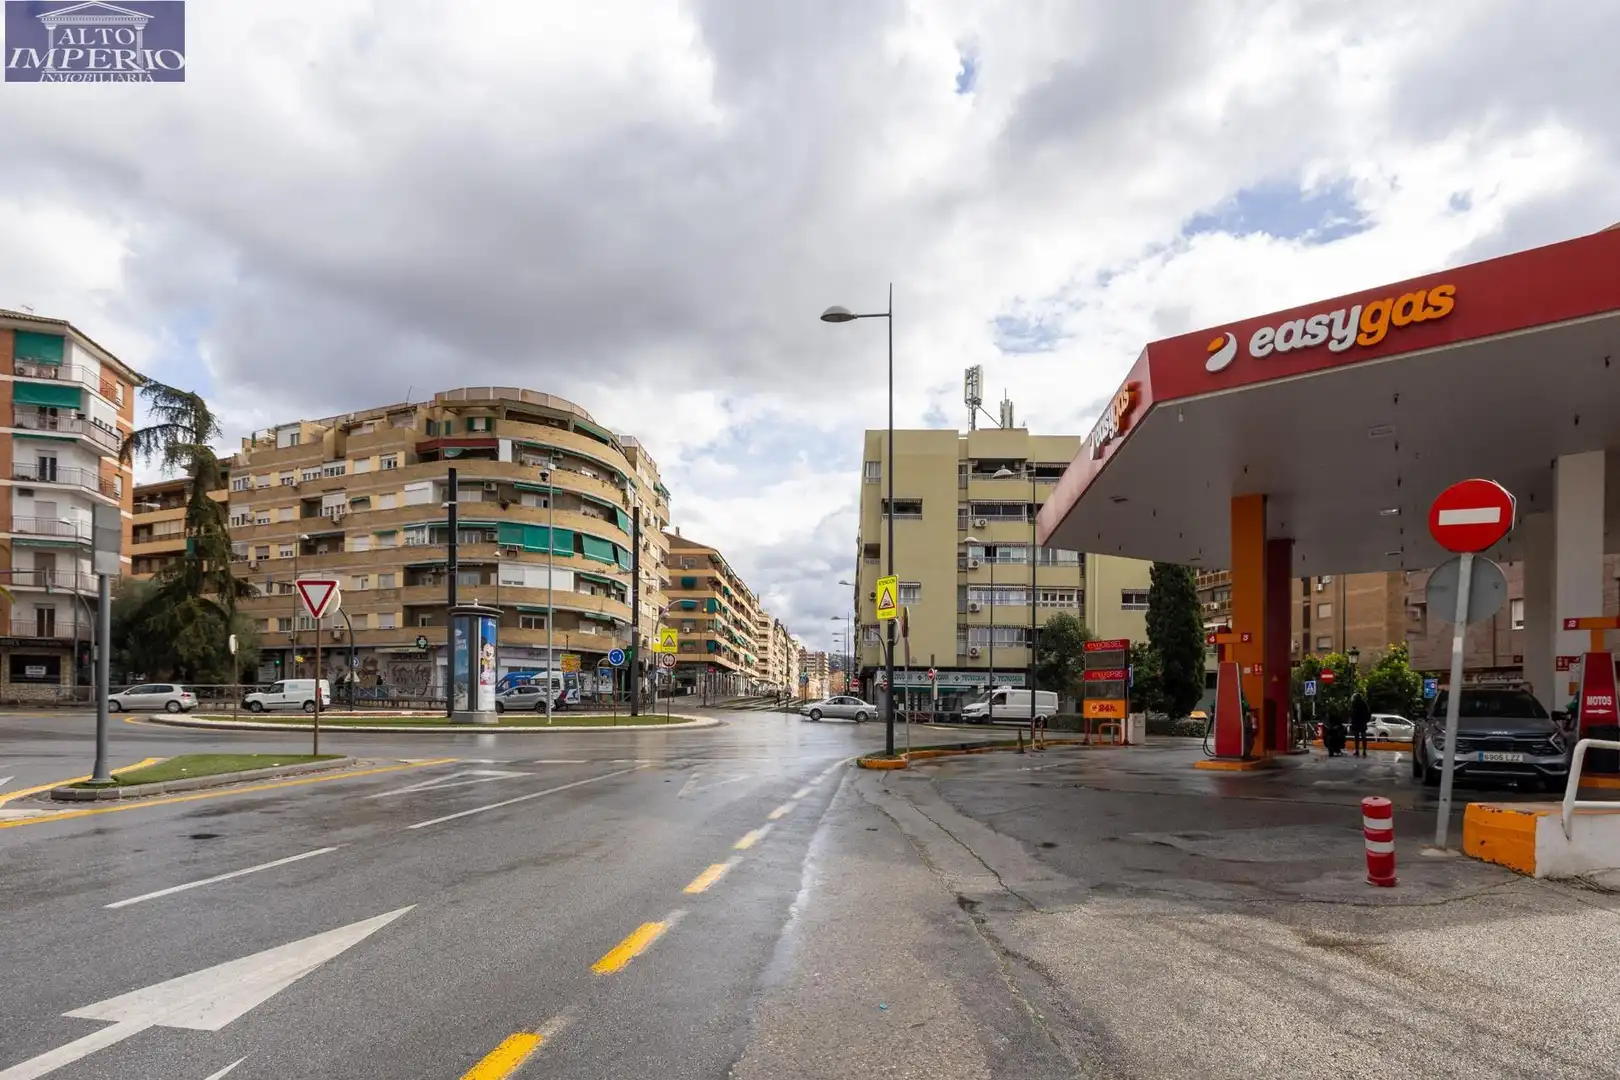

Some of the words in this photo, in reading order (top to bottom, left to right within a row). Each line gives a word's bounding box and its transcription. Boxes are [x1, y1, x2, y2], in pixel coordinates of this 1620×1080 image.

[1249, 284, 1456, 358] easygas
[1094, 382, 1132, 448] easygas
[1587, 696, 1612, 706] MOTOS
